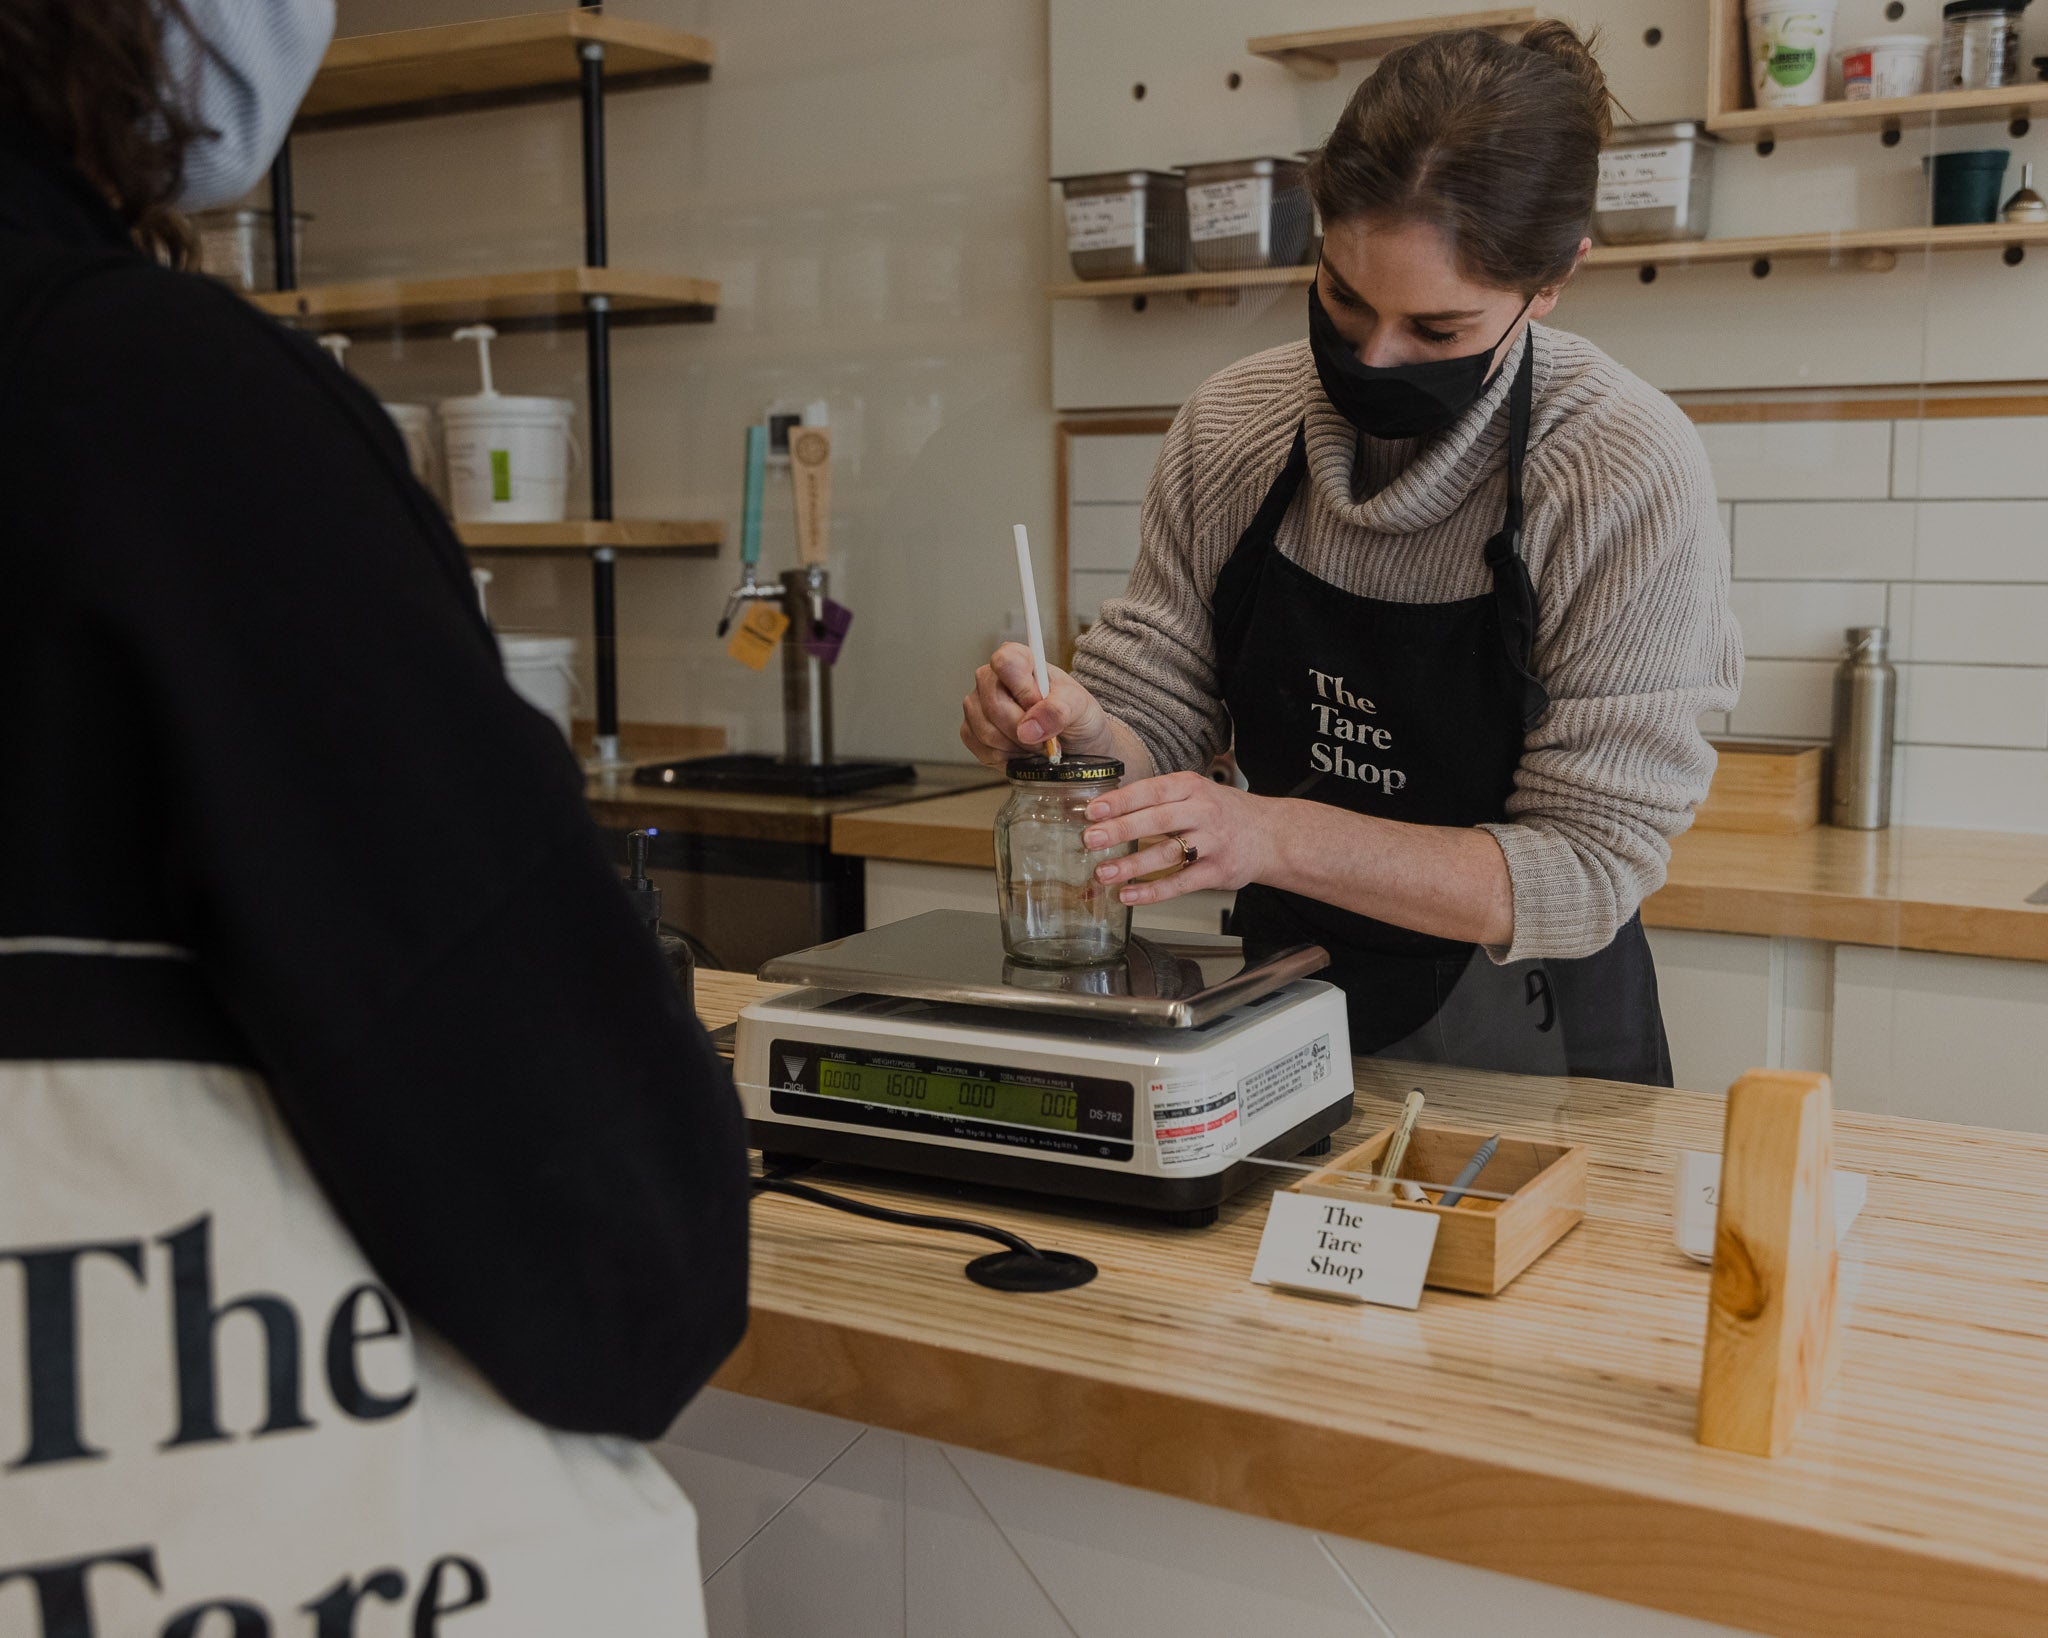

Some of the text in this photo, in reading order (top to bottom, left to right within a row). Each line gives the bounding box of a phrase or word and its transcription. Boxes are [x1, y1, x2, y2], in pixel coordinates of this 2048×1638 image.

[1308, 668, 1377, 714] The
[1311, 703, 1392, 750] Tare
[1016, 770, 1049, 780] MAILLE
[1082, 767, 1116, 779] MAILLE
[1310, 742, 1407, 795] Shop
[831, 1052, 847, 1060] TARE
[872, 1057, 916, 1069] WEIGHT/POIDS
[936, 1065, 968, 1075] PRICE/PRIX
[1089, 1109, 1122, 1122] DS-782
[1324, 1205, 1363, 1229] The
[1317, 1229, 1362, 1254] Tare
[1307, 1254, 1363, 1284] Shop
[0, 1213, 418, 1473] The
